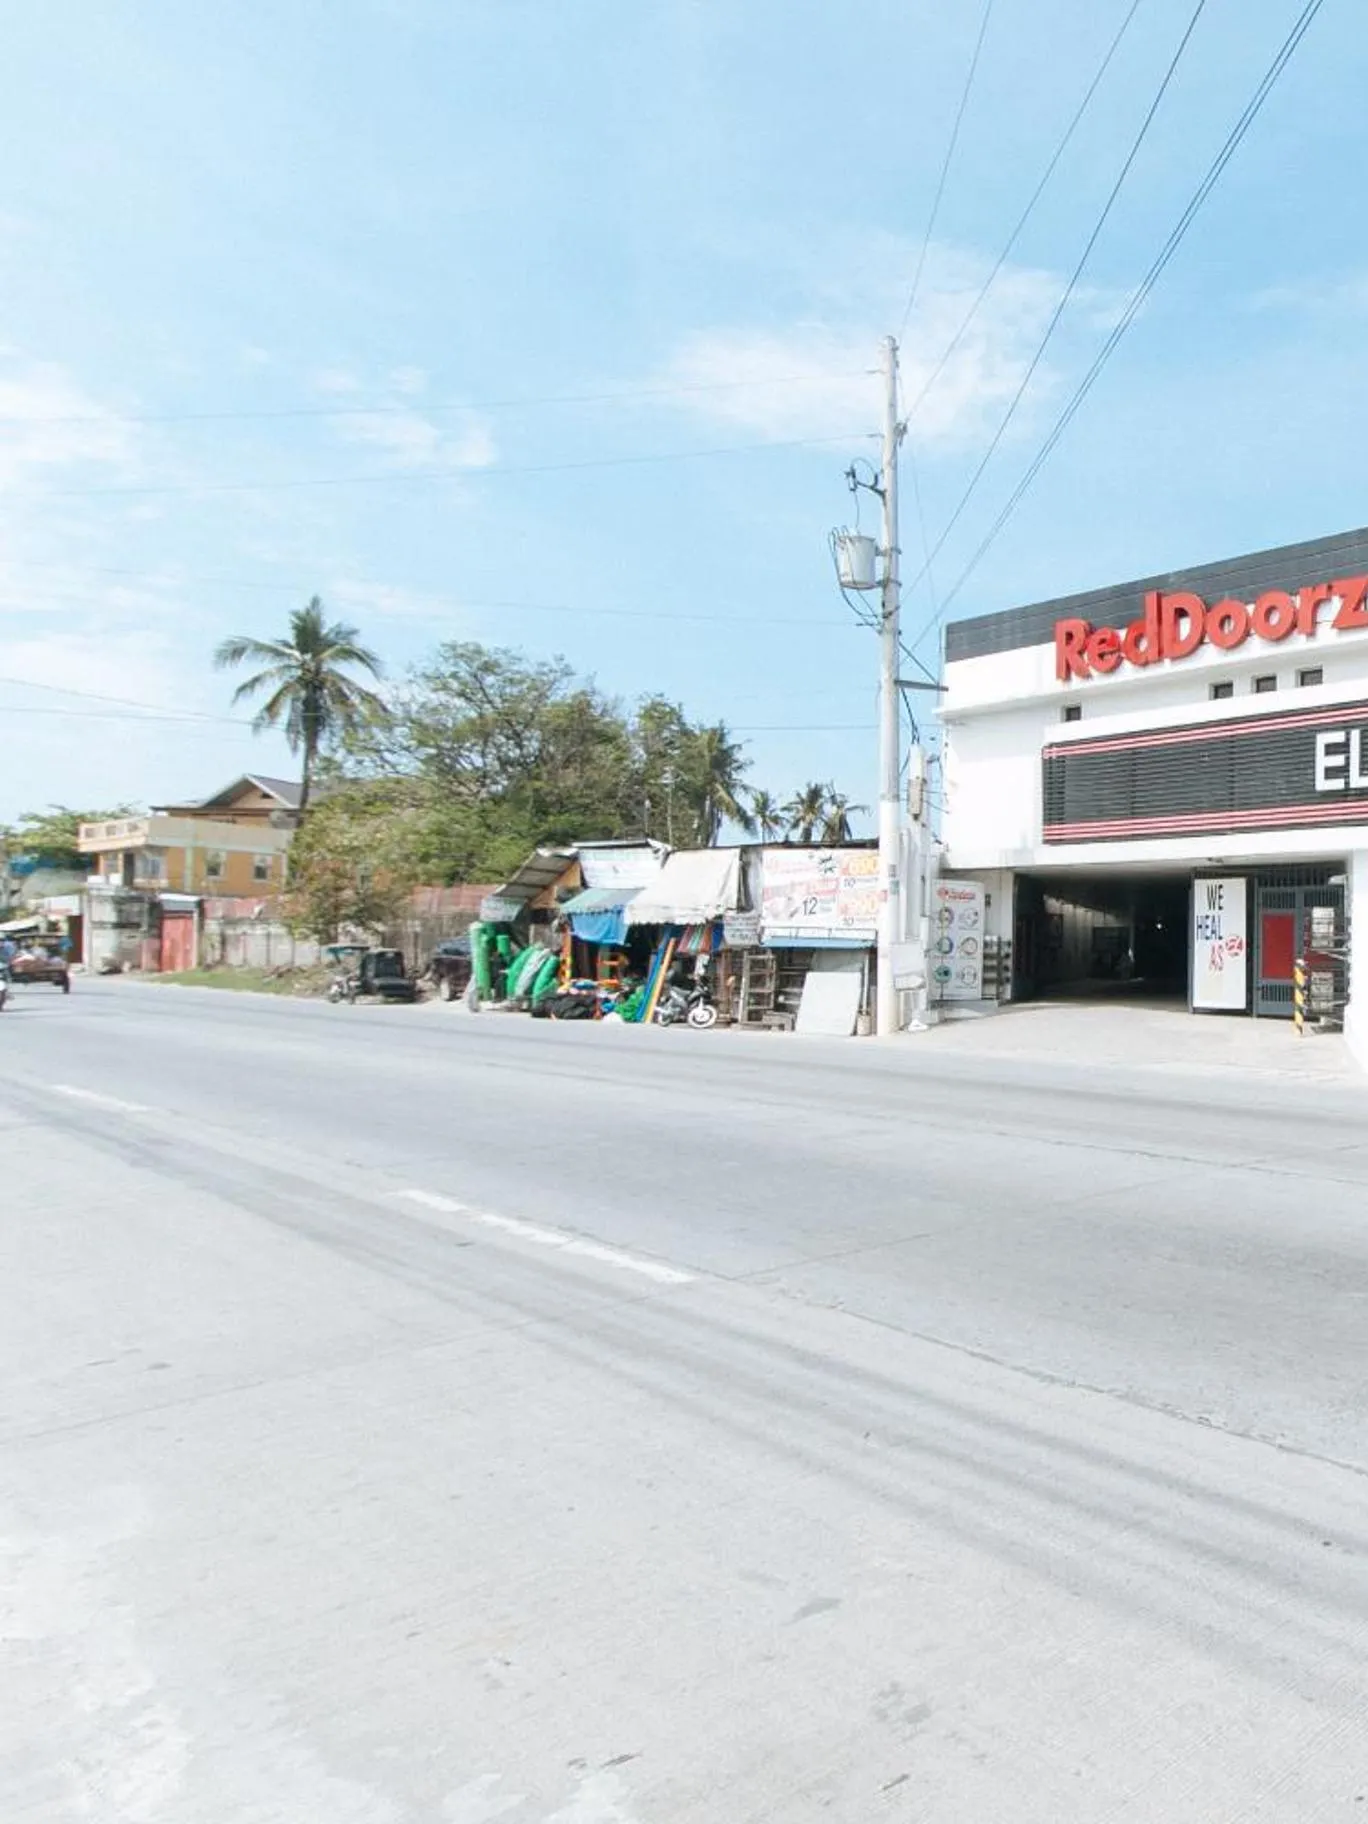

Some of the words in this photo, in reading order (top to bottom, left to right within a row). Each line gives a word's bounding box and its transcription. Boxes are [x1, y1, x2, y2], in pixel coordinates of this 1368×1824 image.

[802, 896, 818, 916] 12
[1207, 884, 1223, 911] WE
[1196, 915, 1223, 941] HEAL
